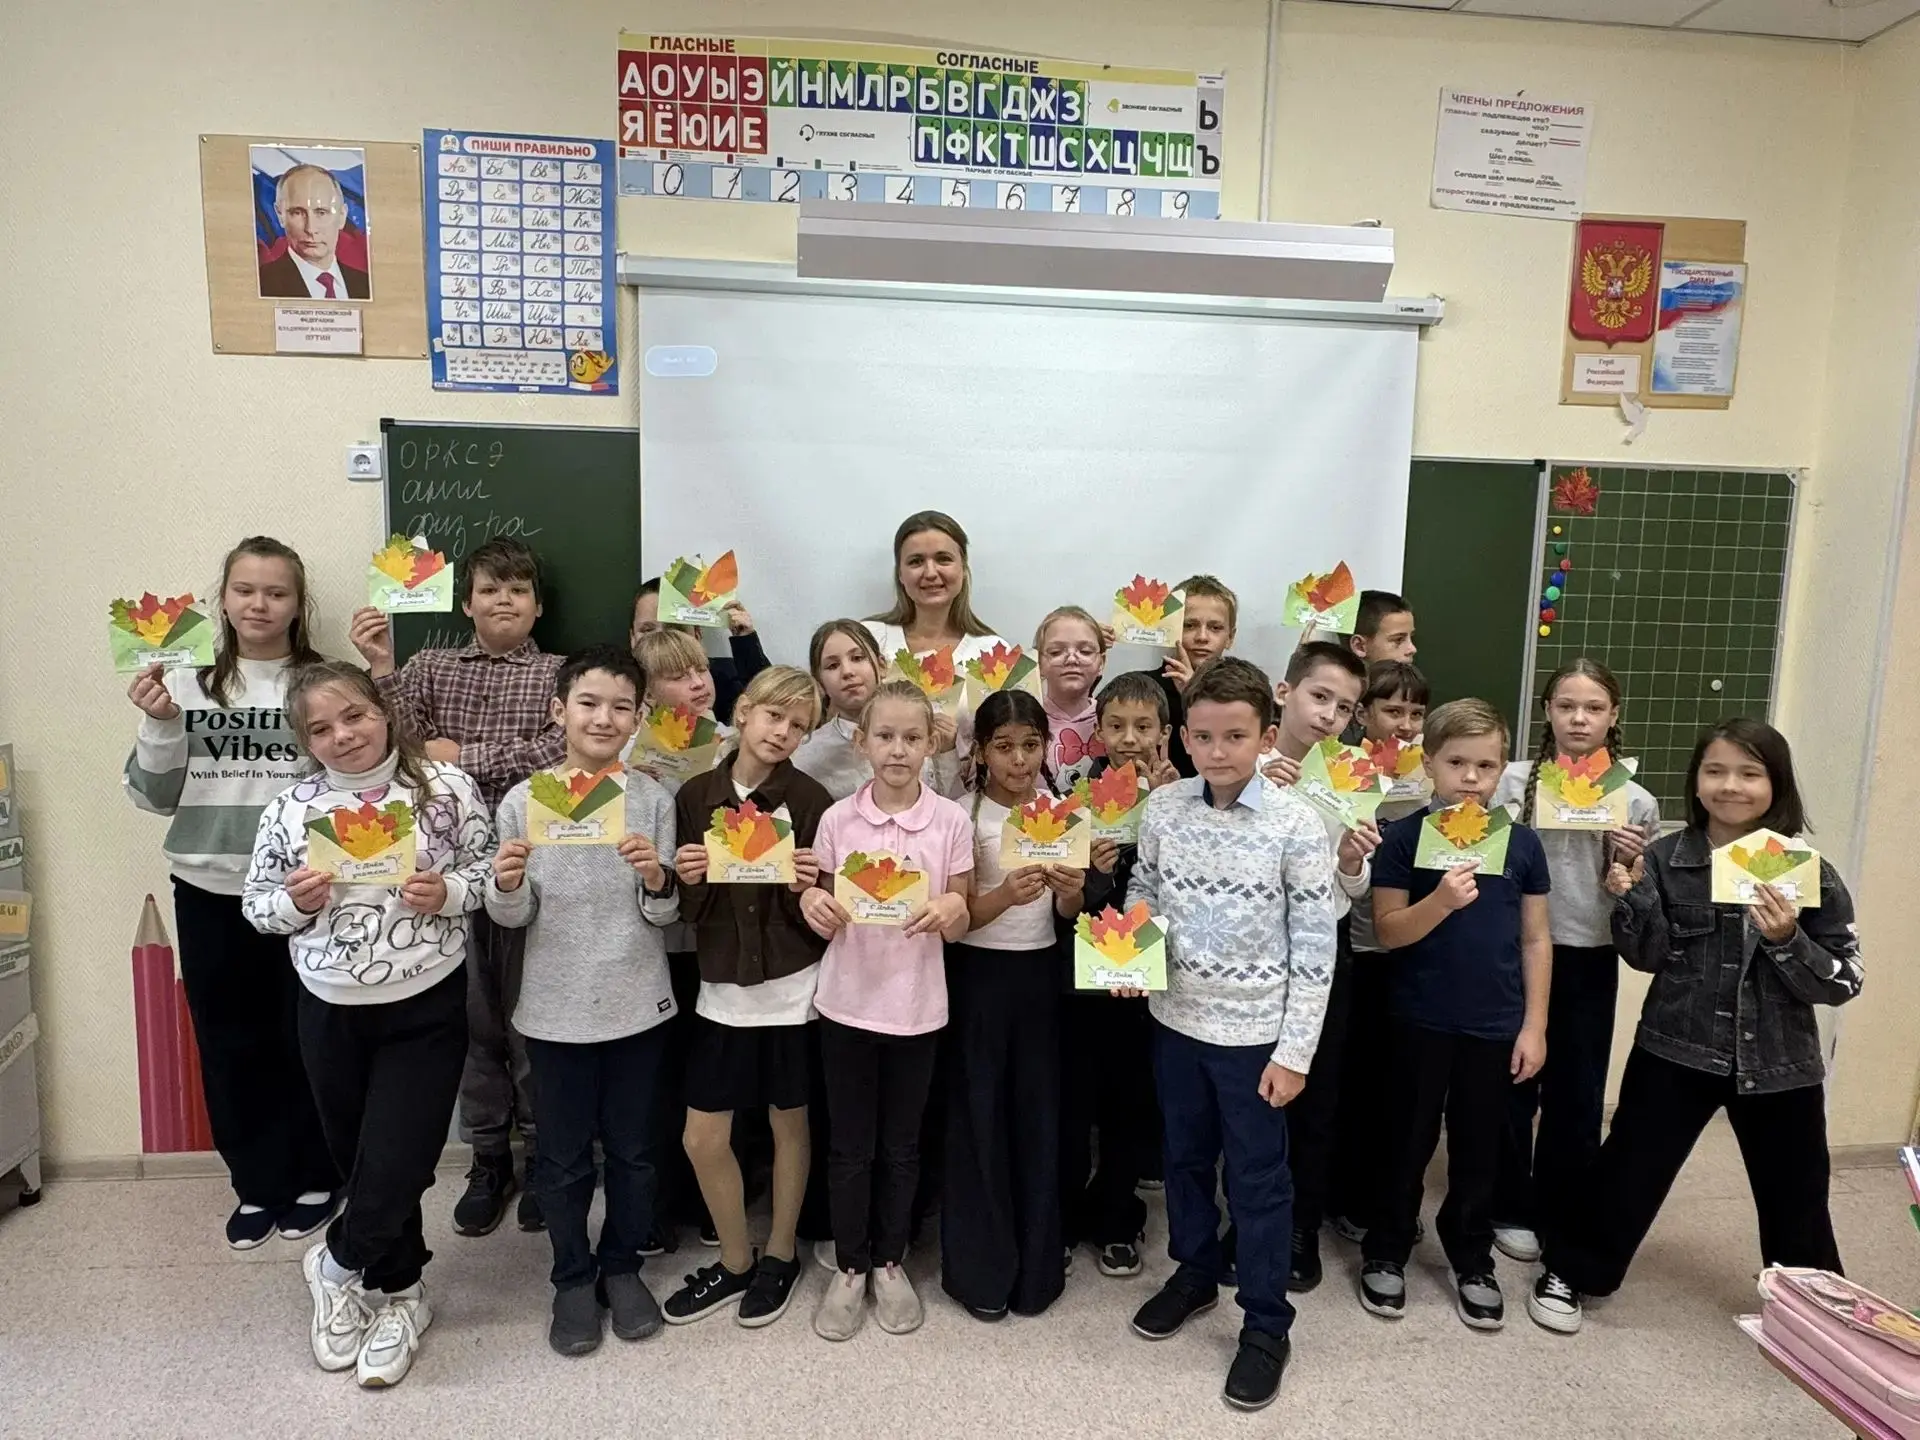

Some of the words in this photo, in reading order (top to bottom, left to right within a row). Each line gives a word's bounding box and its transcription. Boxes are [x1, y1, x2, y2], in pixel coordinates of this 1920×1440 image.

[650, 36, 735, 53] ГЛАСНЫЕ
[936, 51, 1040, 74] СОГЛАСНЫЕ
[1452, 93, 1492, 107] ЧЛЕНЫ
[1496, 99, 1584, 116] ПРЕДЛОЖЕНИЯ
[472, 140, 511, 152] ПИШИ
[514, 142, 591, 156] ПРАВИЛЬНО
[663, 163, 684, 195] 0
[728, 168, 742, 199] 1
[778, 170, 800, 202] 2
[840, 174, 857, 201] 3
[896, 176, 914, 204] 4
[951, 180, 970, 208] 5
[1006, 184, 1025, 210] 6
[1060, 186, 1081, 212] 7
[1116, 189, 1135, 216] 8
[1174, 191, 1190, 219] 9
[185, 706, 286, 732] Positi
[202, 735, 298, 762] Vibes
[190, 771, 218, 779] With
[221, 770, 250, 778] Belief
[252, 770, 262, 778] In
